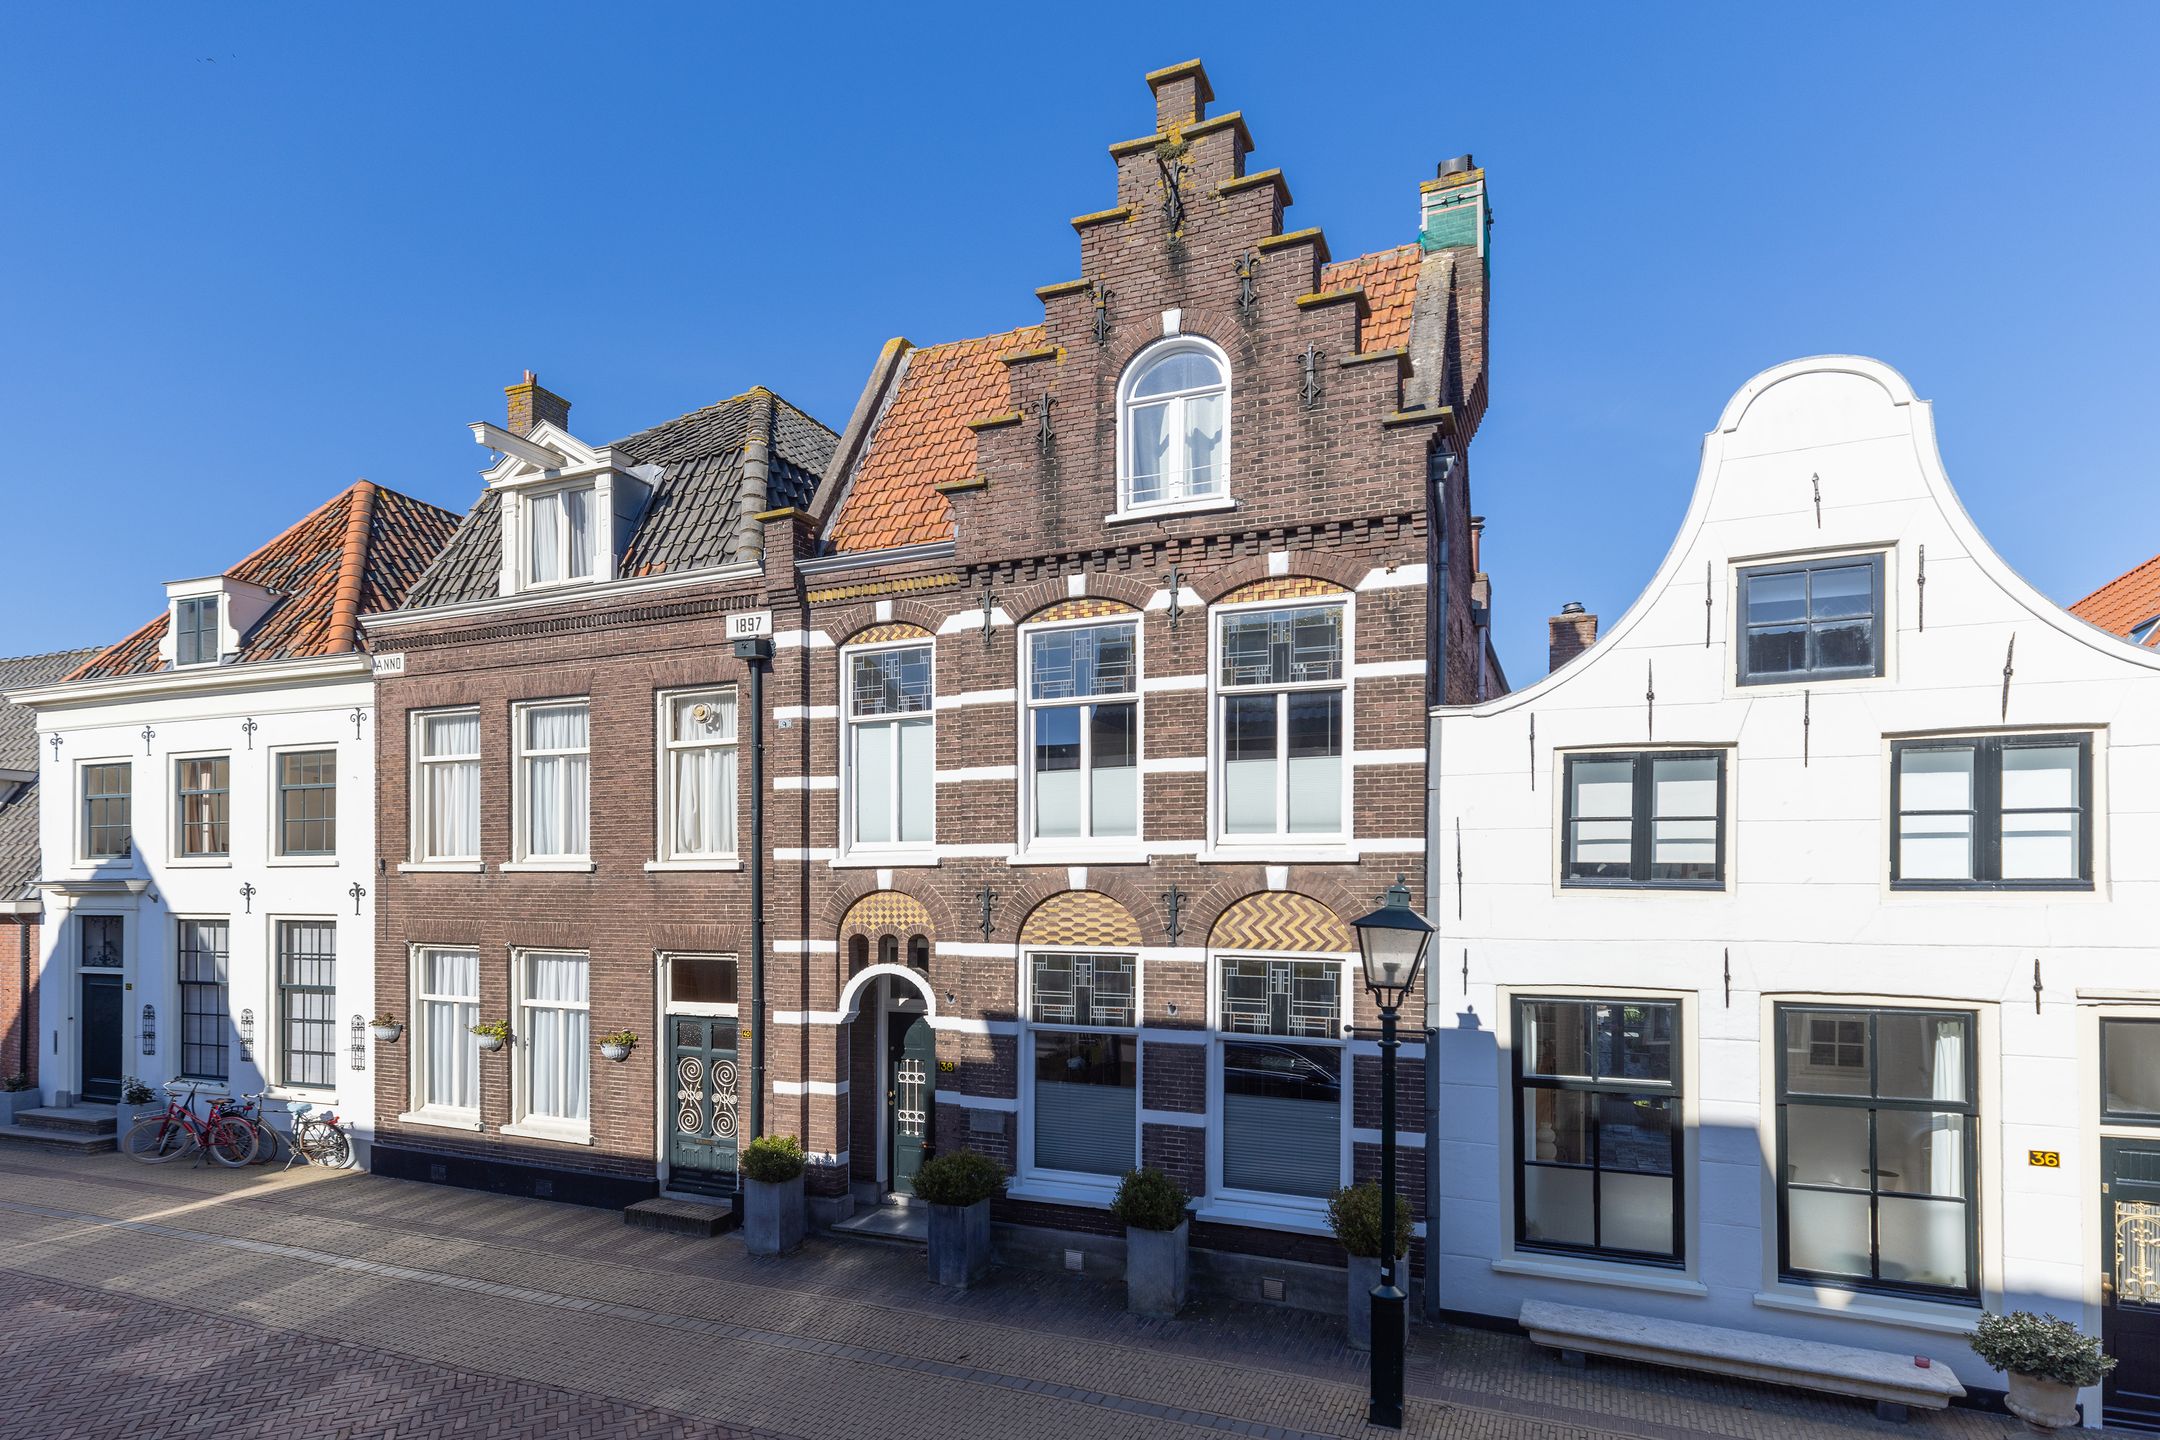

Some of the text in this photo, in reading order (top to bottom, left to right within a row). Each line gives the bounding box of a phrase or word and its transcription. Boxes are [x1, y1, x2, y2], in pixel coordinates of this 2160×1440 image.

[735, 616, 762, 633] 1897
[376, 657, 401, 671] ANNO
[940, 1061, 953, 1072] 38
[2031, 1151, 2058, 1167] 36
